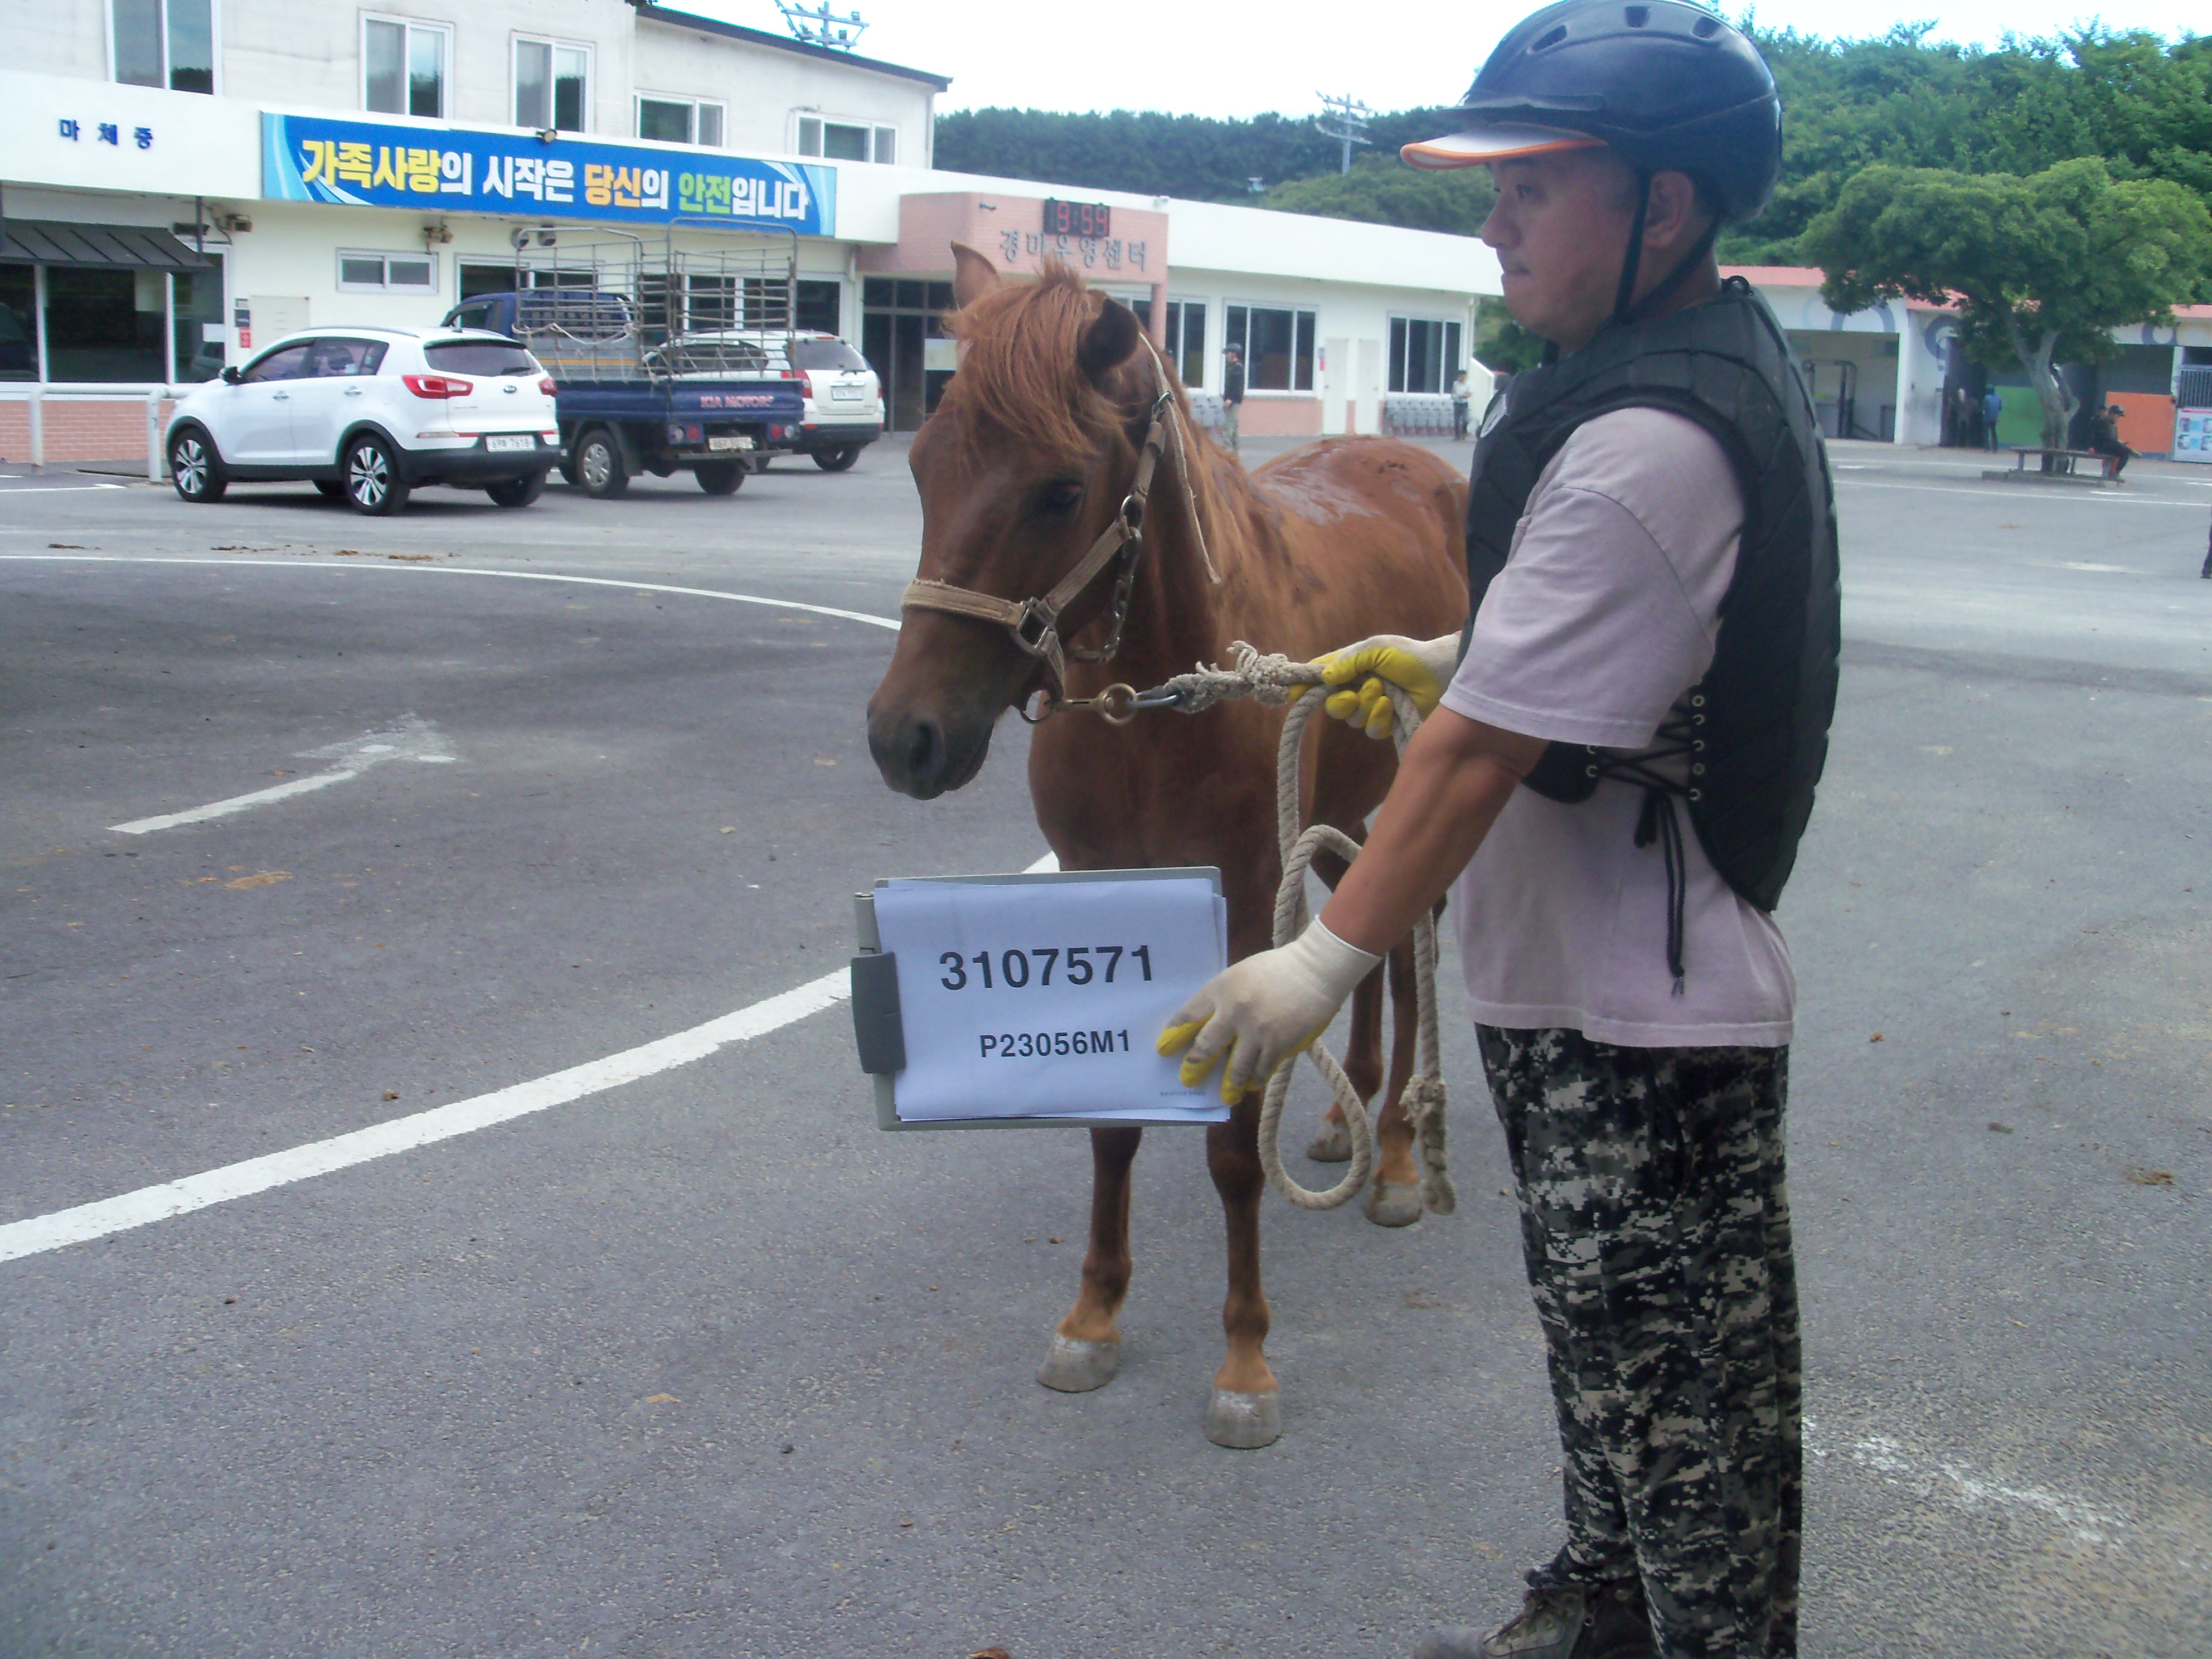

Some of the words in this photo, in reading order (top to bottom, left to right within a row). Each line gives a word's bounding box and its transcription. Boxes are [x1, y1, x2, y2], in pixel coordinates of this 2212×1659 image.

[303, 139, 473, 196] 가족사랑의
[483, 155, 574, 203] 시작은
[585, 164, 668, 210] 당신의
[679, 172, 809, 220] 안전입니다
[1000, 230, 1147, 272] 경마운영센터
[700, 396, 722, 408] KIA
[939, 944, 1152, 991] 3107571
[979, 1029, 1129, 1058] P23056M1
